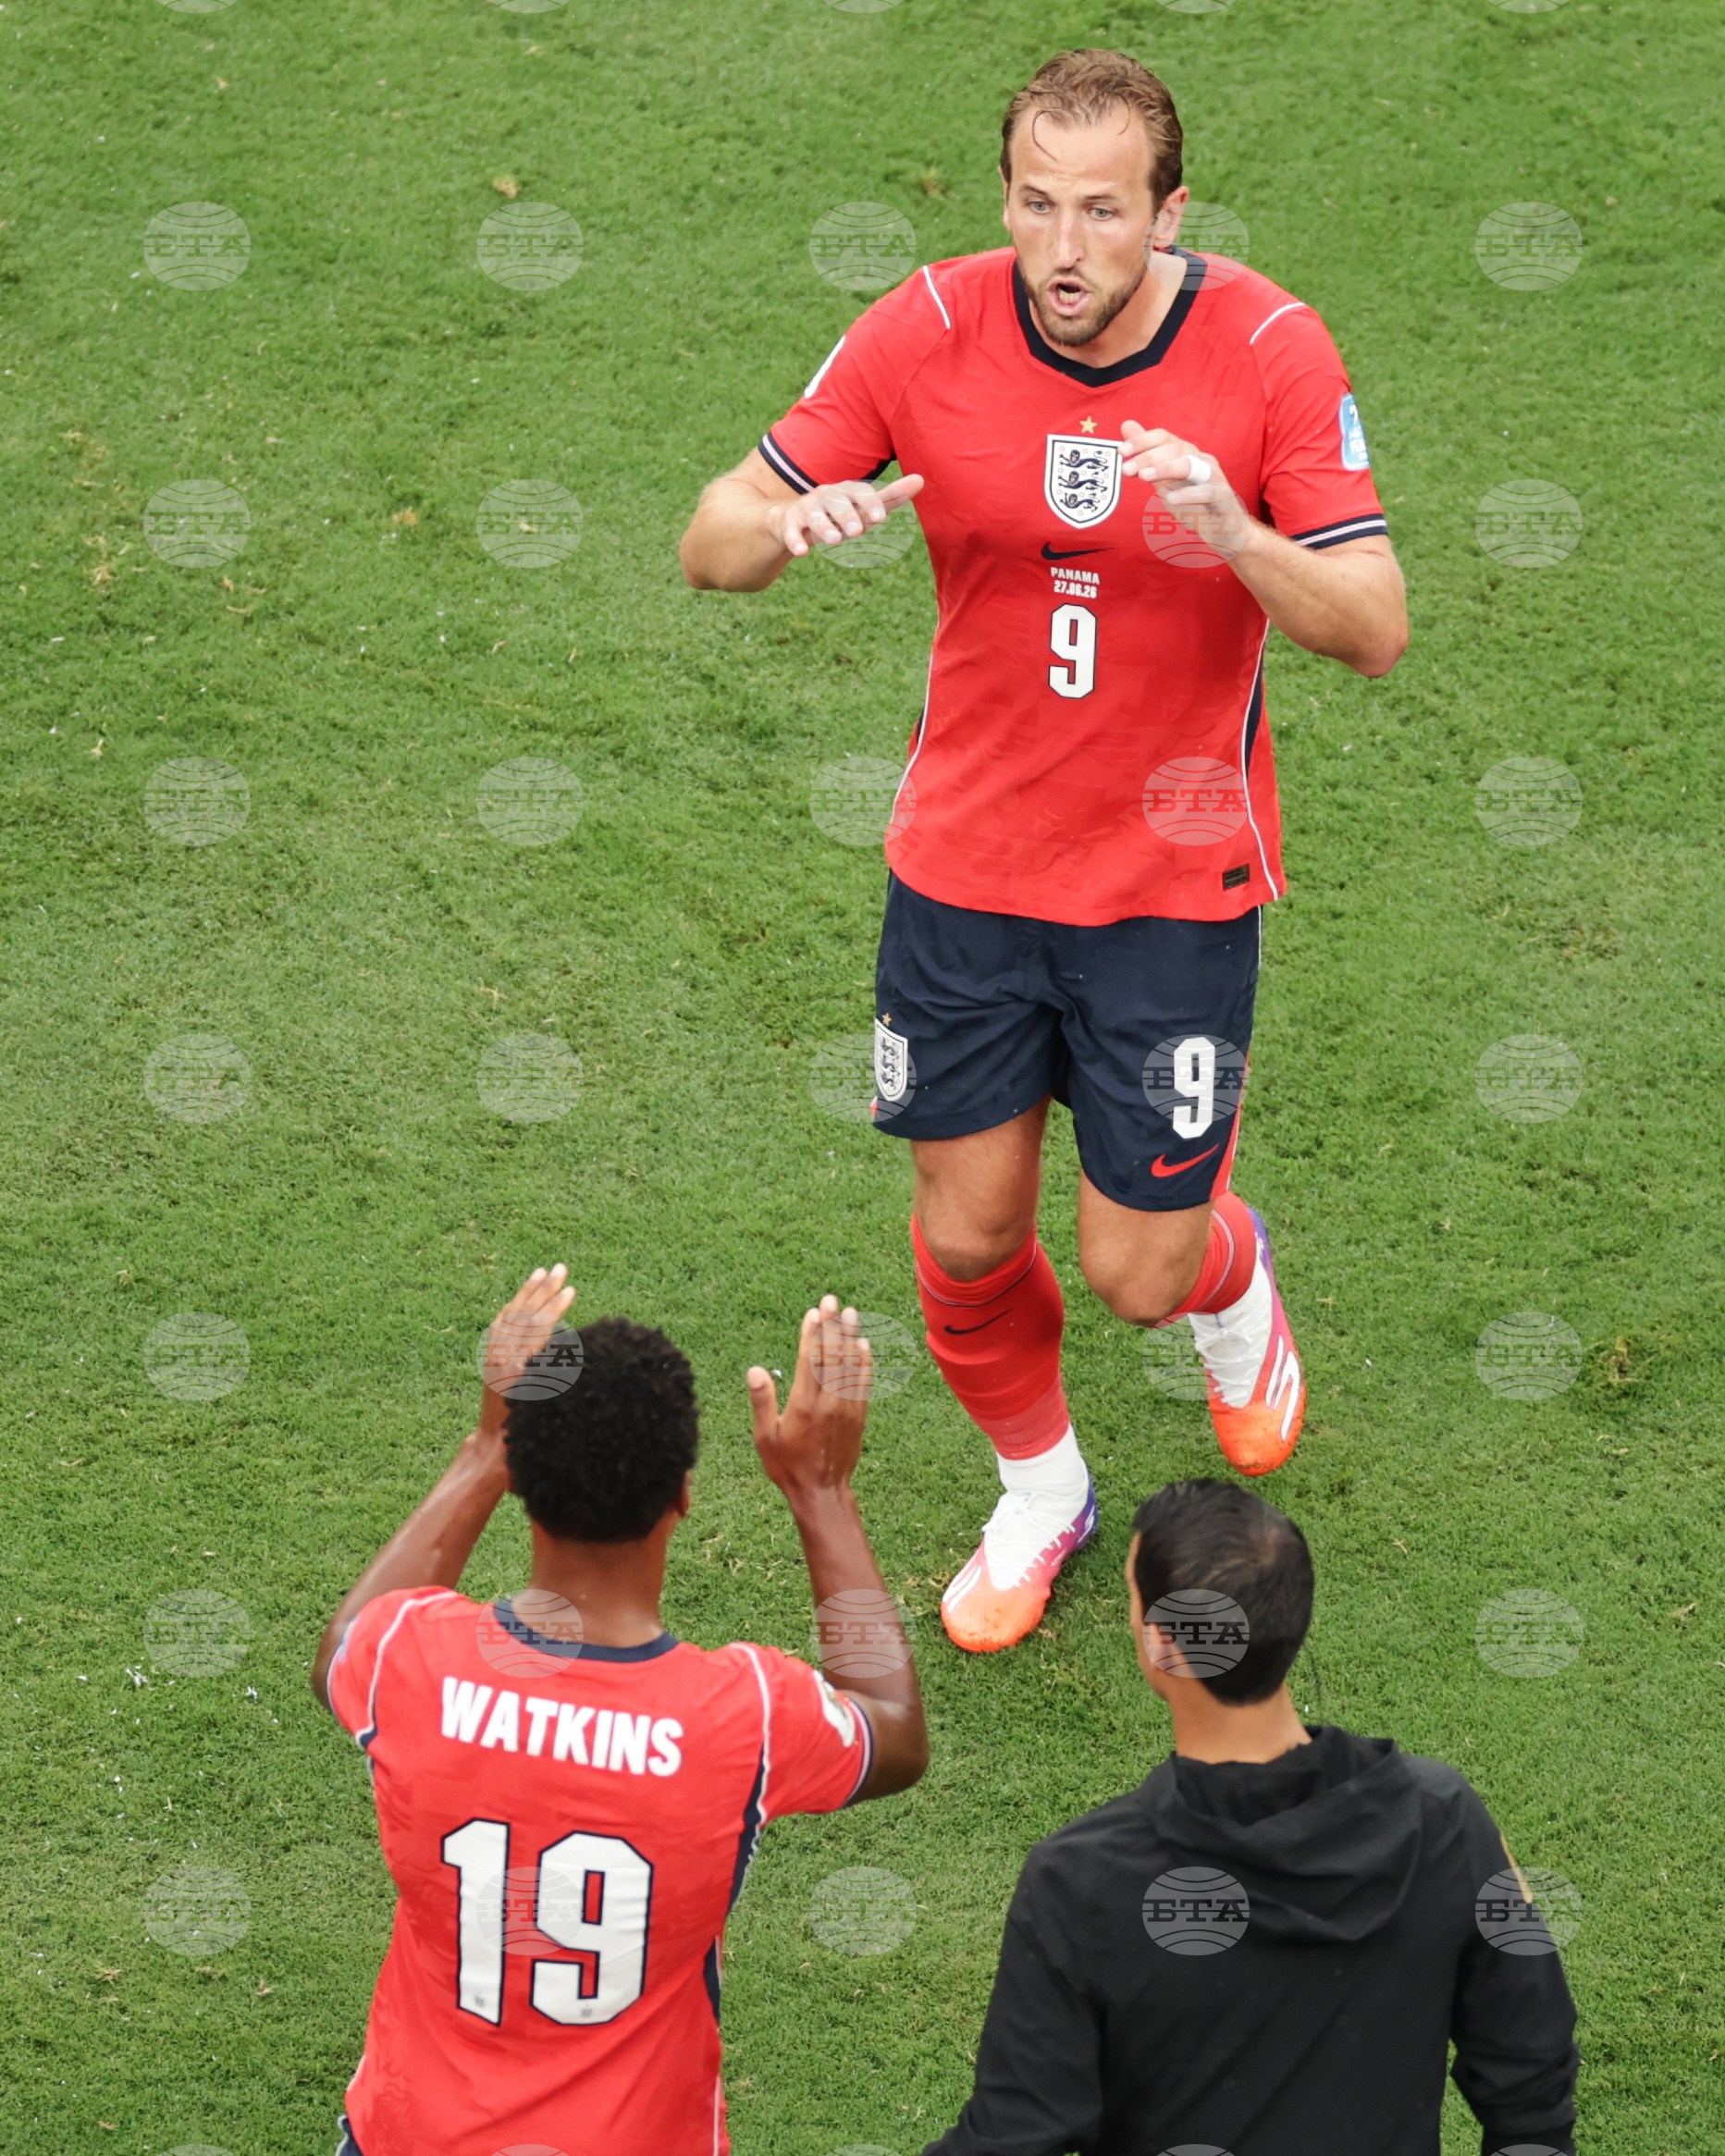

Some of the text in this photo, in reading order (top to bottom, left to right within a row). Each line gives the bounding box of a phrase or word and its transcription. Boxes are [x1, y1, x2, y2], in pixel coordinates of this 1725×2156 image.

[1050, 566, 1101, 585] PANAMA
[1053, 580, 1098, 599] 27.06.26
[1048, 603, 1097, 699] 9
[1172, 1037, 1215, 1139] 9
[440, 1675, 684, 1777] WATKINS
[440, 1817, 654, 2027] 19
